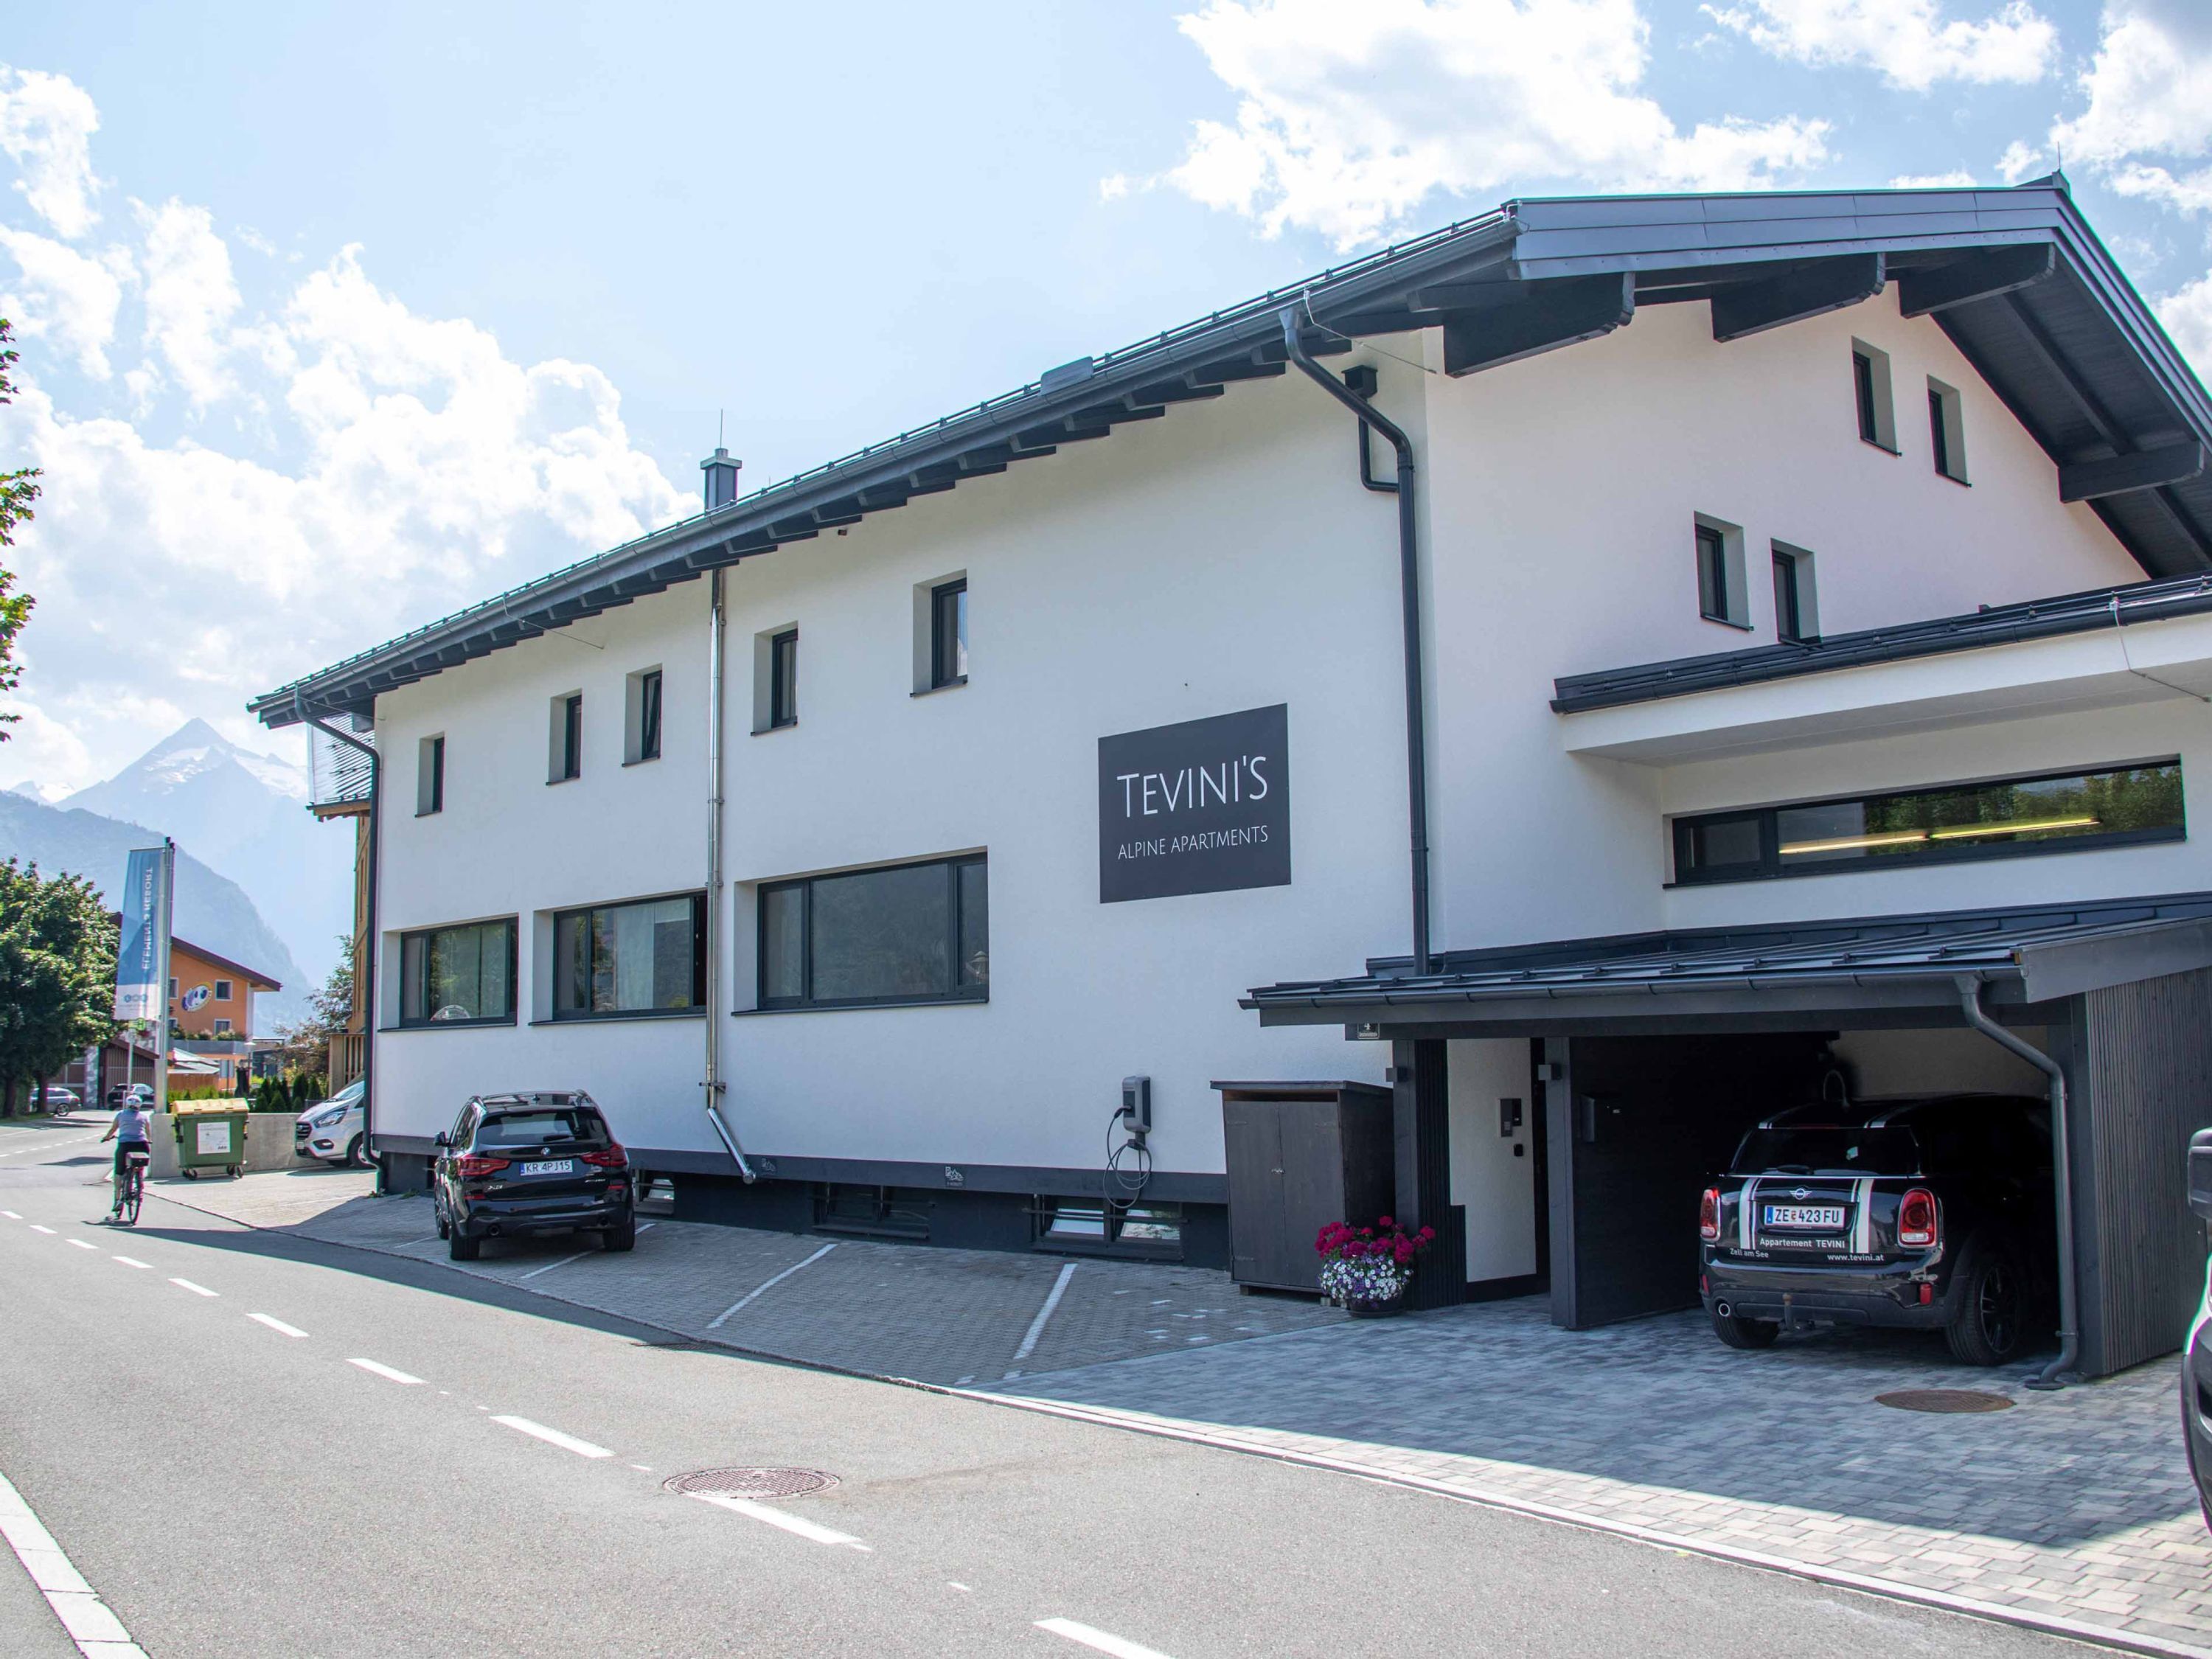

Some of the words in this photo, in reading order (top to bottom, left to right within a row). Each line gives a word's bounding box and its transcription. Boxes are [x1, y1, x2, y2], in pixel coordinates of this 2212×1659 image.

[1116, 755, 1268, 818] TEVINI'S
[1118, 838, 1166, 860] ALPINE
[1171, 825, 1268, 853] APARTMENTS
[526, 1164, 538, 1172] KR
[542, 1161, 571, 1171] 4PJ15
[1775, 1208, 1790, 1222] ZE
[1759, 1238, 1812, 1248] Appartement
[1815, 1239, 1846, 1248] TEVINI
[1729, 1248, 1742, 1256] Zell
[1755, 1250, 1769, 1258] See
[1827, 1253, 1885, 1262] www.tevini.at
